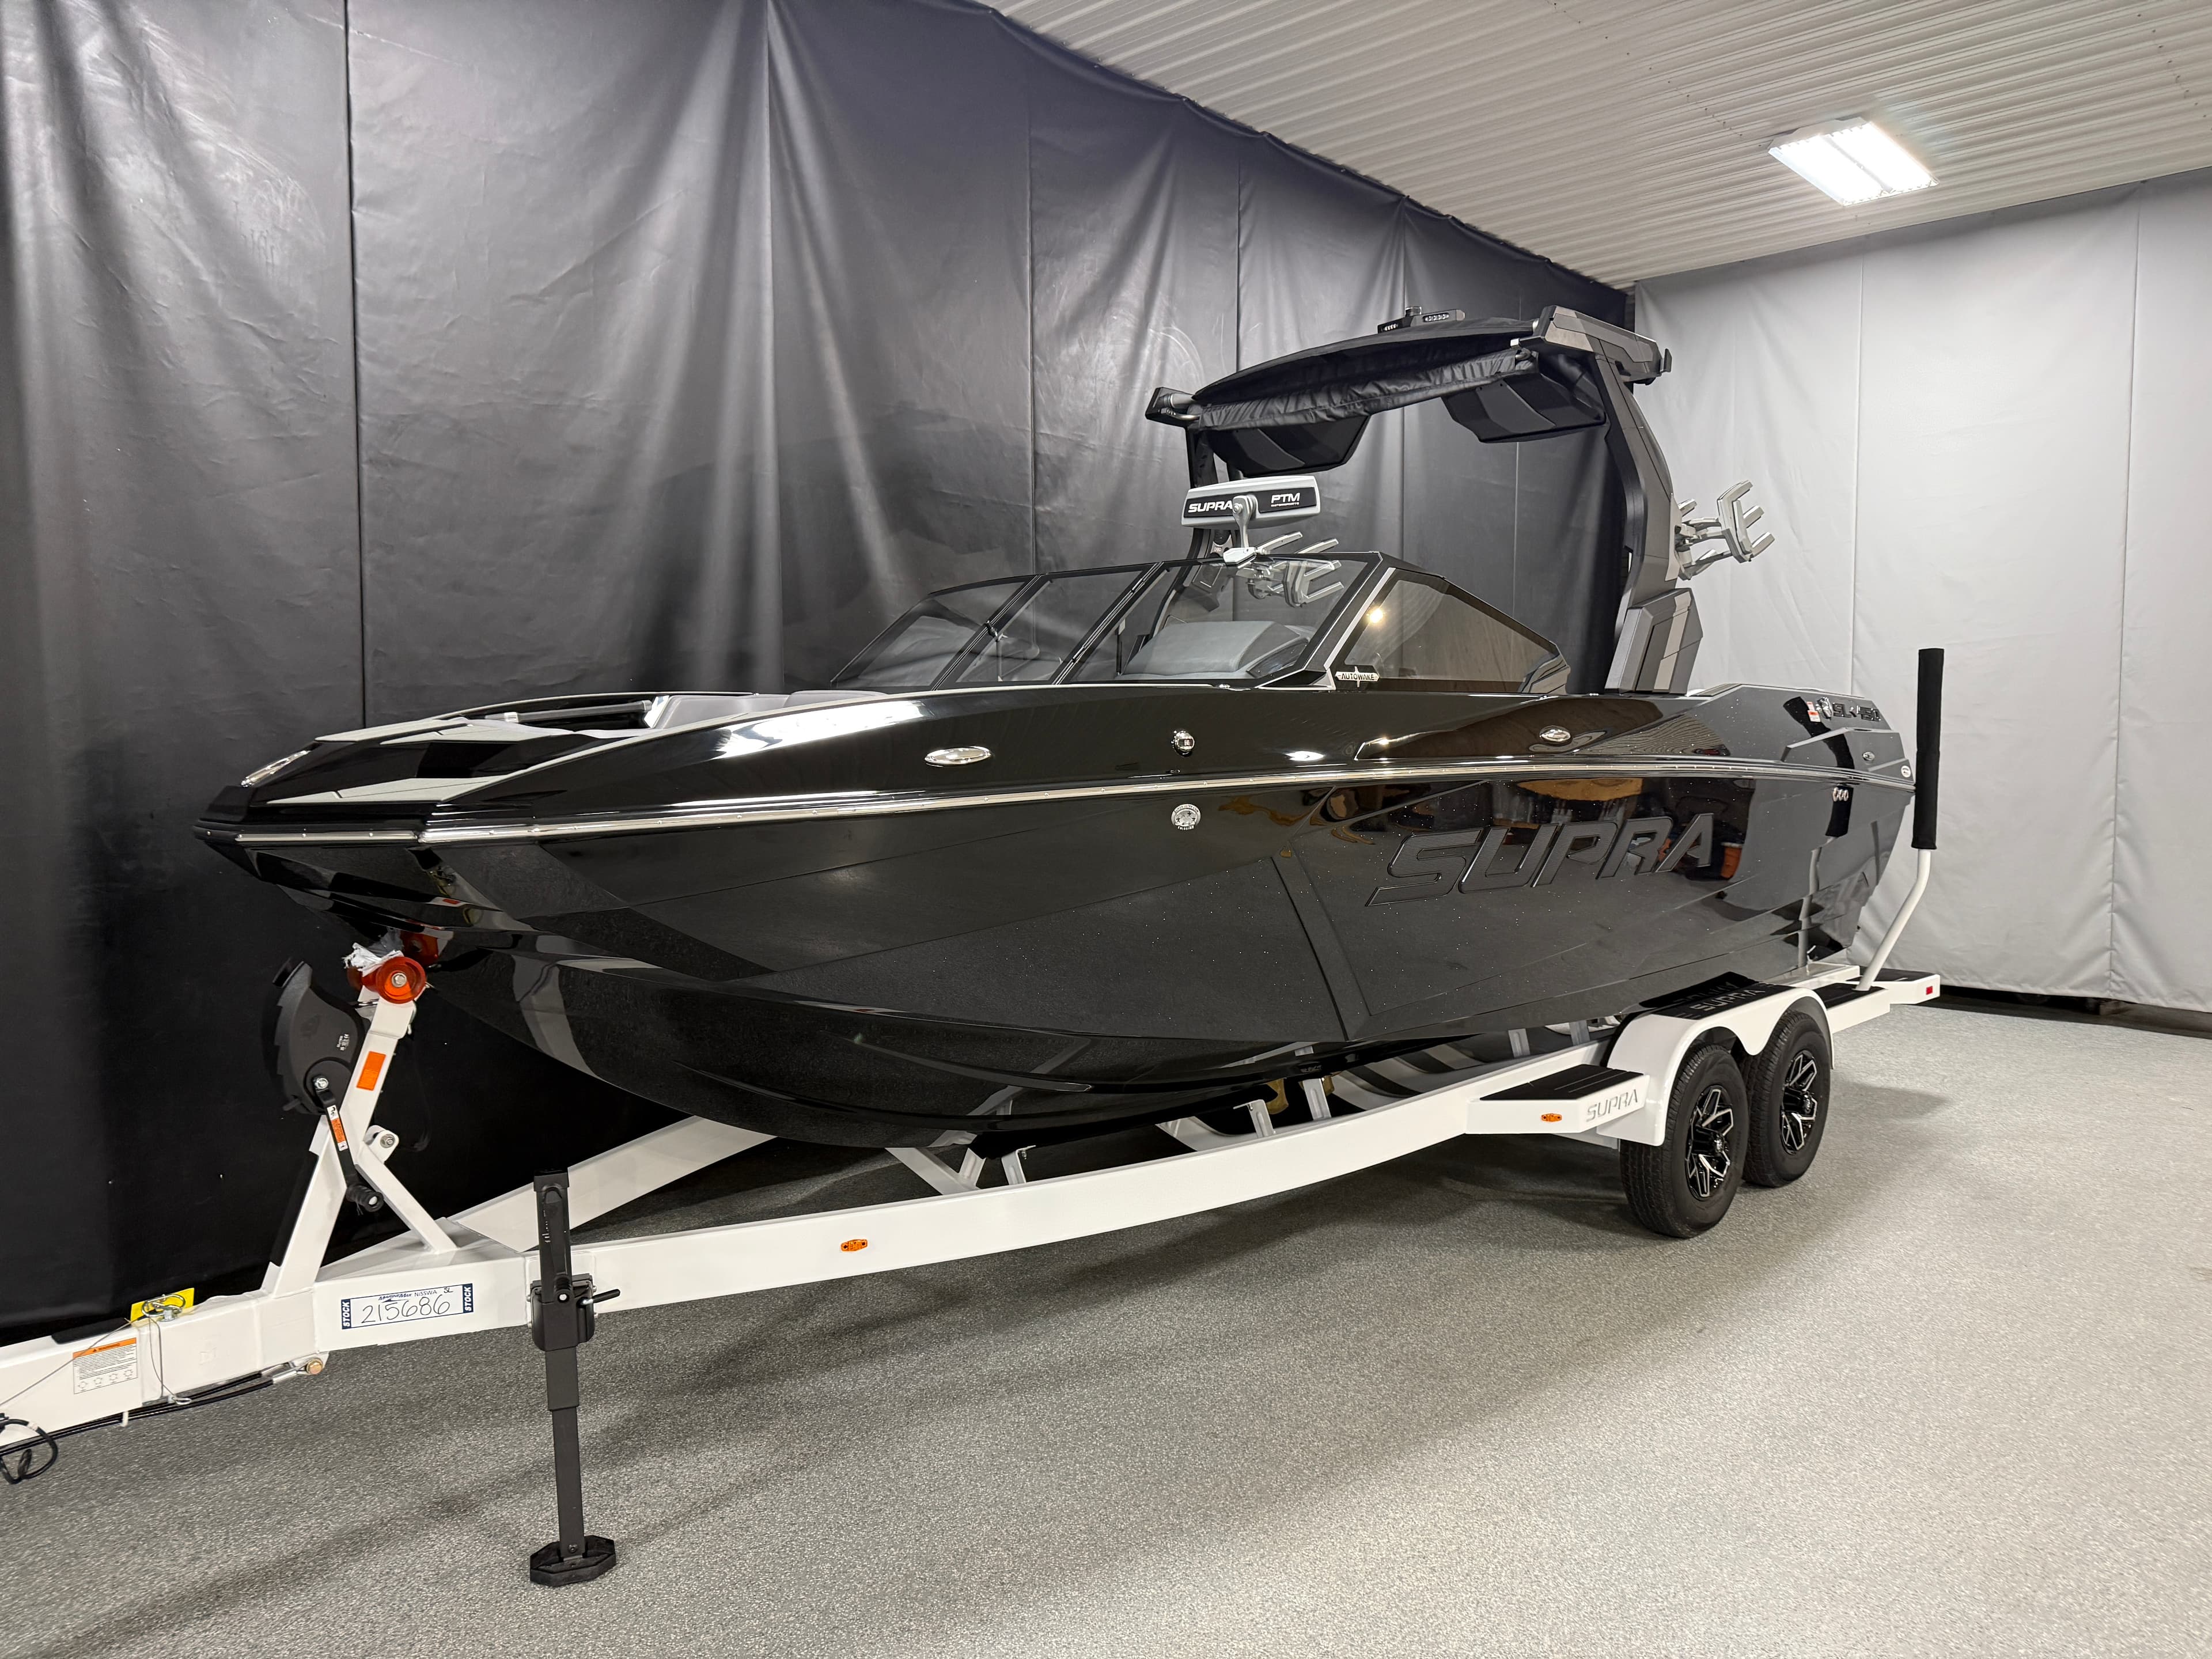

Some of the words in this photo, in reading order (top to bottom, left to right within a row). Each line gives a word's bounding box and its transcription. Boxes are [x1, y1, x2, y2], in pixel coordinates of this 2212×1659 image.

[1188, 500, 1233, 513] SUPRA
[1271, 493, 1301, 503] PTM
[1341, 672, 1375, 681] AUTOWAKE
[1365, 812, 1714, 907] SUPRA
[1689, 988, 1766, 1012] SUPRA
[1586, 1089, 1638, 1122] SUPRA
[361, 1294, 450, 1324] 215686
[463, 1286, 472, 1312] STOCK
[342, 1301, 351, 1327] STOCK
